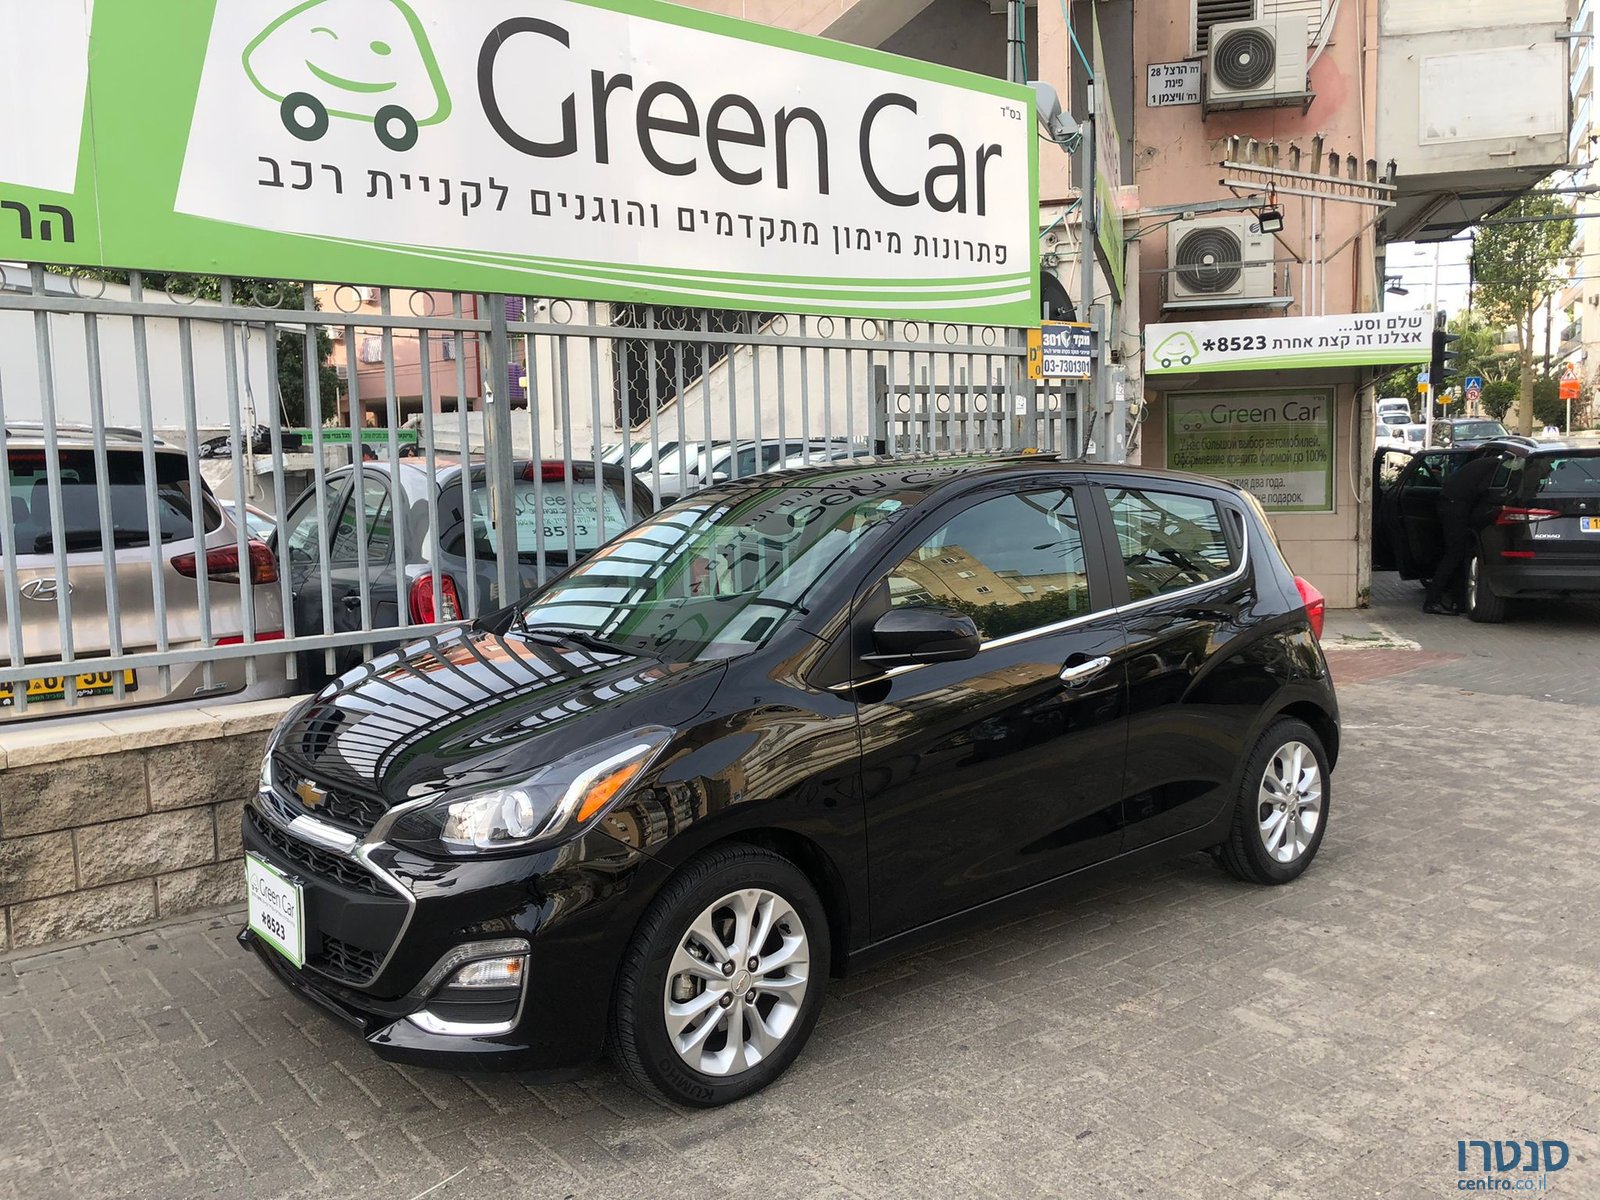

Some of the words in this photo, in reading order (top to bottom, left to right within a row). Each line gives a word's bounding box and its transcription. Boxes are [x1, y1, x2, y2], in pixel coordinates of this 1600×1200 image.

[1151, 68, 1161, 77] 28
[1164, 65, 1187, 75] הרצל
[1165, 79, 1184, 88] פינת
[1152, 95, 1156, 103] 1
[477, 17, 829, 195] Green
[860, 92, 1002, 217] Car
[1000, 106, 1021, 120] בס"ד
[258, 156, 342, 194] רכב
[367, 169, 509, 217] לקניית
[530, 189, 658, 229] והוגנים
[677, 206, 819, 247] מתקדמים
[832, 225, 901, 254] מימון
[914, 234, 1007, 265] פתרונות
[1339, 318, 1380, 331] וסע...
[1387, 316, 1422, 329] שלם
[1043, 333, 1061, 346] 301
[1272, 337, 1313, 350] אחרת
[1318, 335, 1350, 349] קצת
[1356, 336, 1373, 345] זה
[1378, 331, 1422, 344] אצלנו
[1044, 359, 1090, 373] 03-7301301
[1211, 404, 1276, 423] Green
[1283, 401, 1321, 421] Car
[1293, 452, 1304, 465] до
[1306, 449, 1327, 463] 100%
[1250, 478, 1264, 490] два
[260, 878, 281, 909] Green
[282, 895, 295, 918] Car
